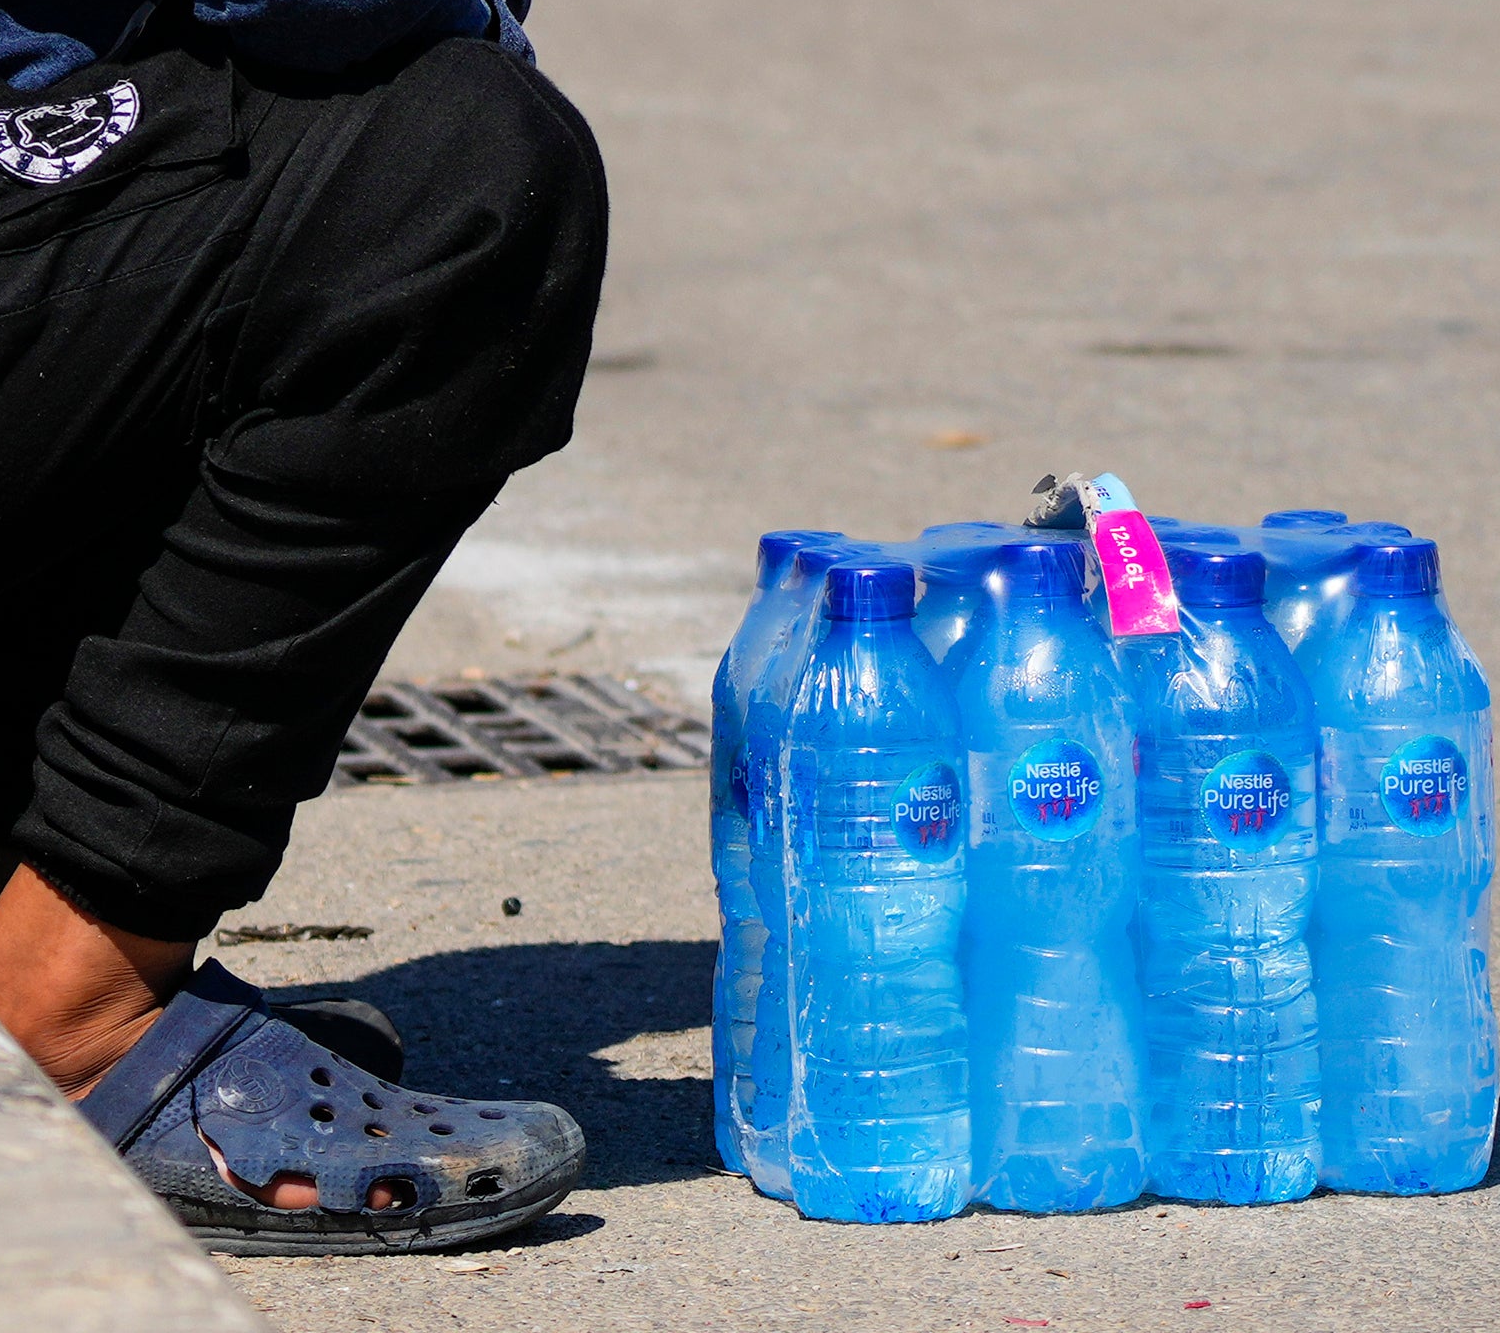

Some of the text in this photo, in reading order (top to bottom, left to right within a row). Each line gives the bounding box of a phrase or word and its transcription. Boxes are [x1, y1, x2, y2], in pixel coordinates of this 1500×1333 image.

[1012, 777, 1100, 805] Pure Life
[1384, 773, 1467, 799] Pure Life
[894, 799, 961, 827] Pure Life
[1204, 789, 1290, 816] Pure Life
